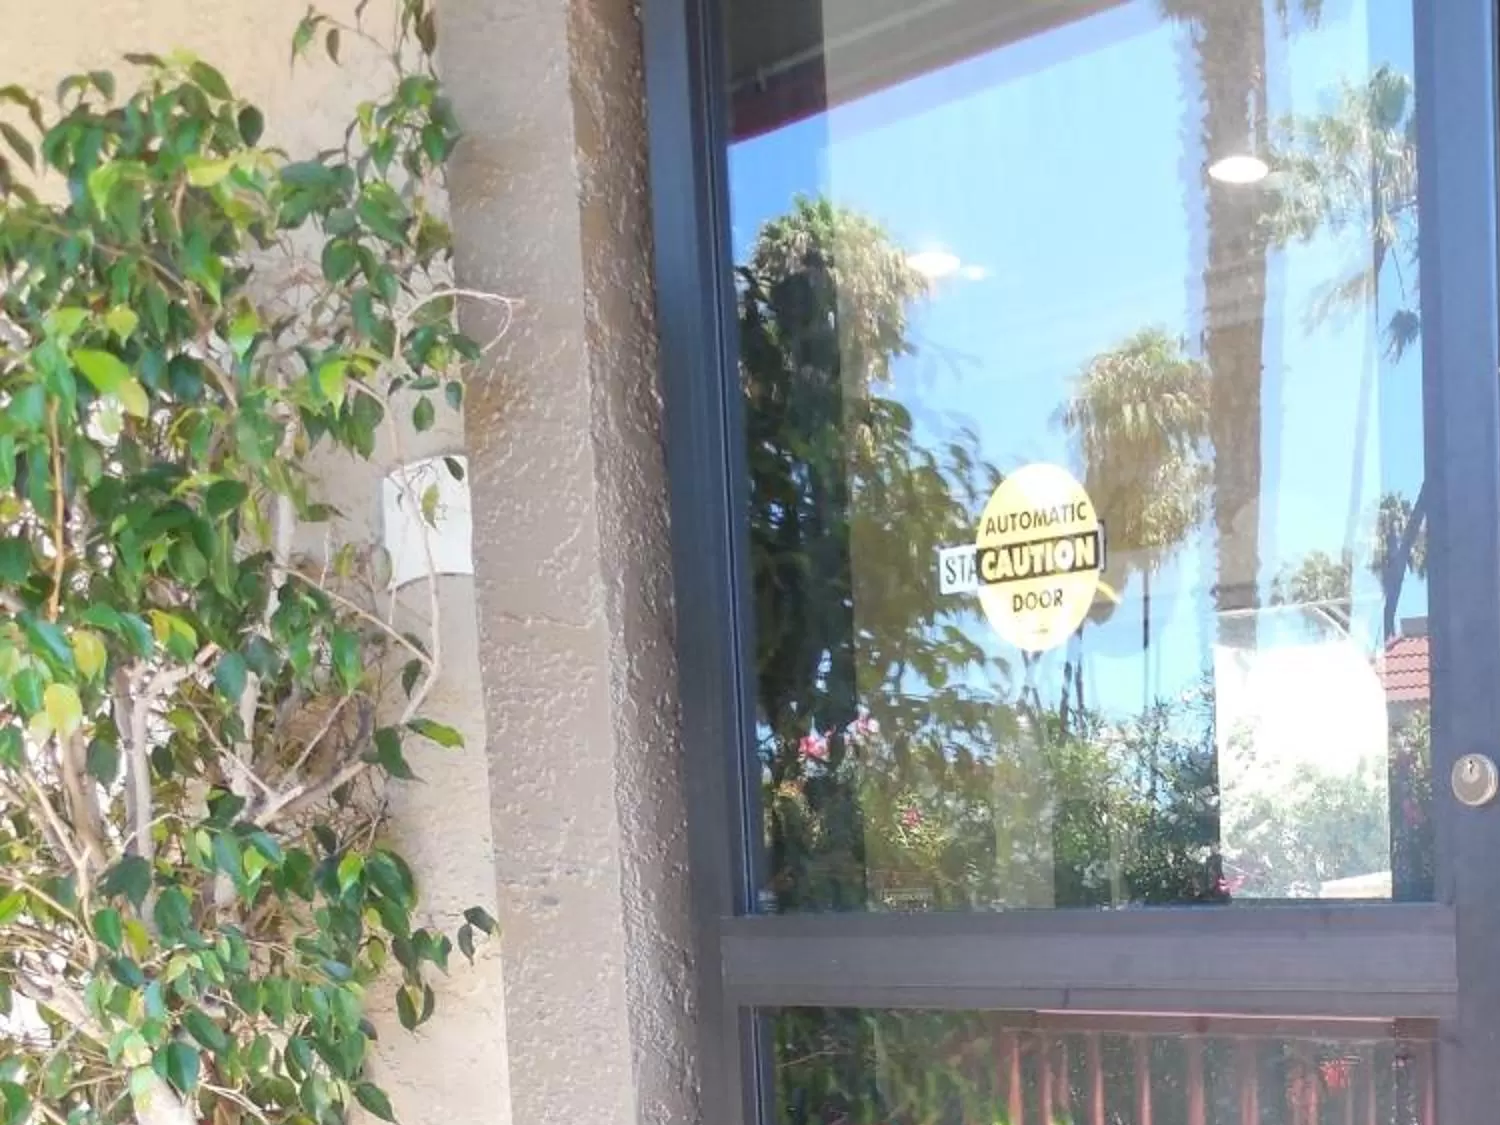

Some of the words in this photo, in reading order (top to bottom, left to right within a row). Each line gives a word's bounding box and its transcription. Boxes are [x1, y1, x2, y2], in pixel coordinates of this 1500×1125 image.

[985, 501, 1088, 537] AUTOMATIC
[981, 535, 1096, 581] CAUTION
[1012, 588, 1063, 613] DOOR
